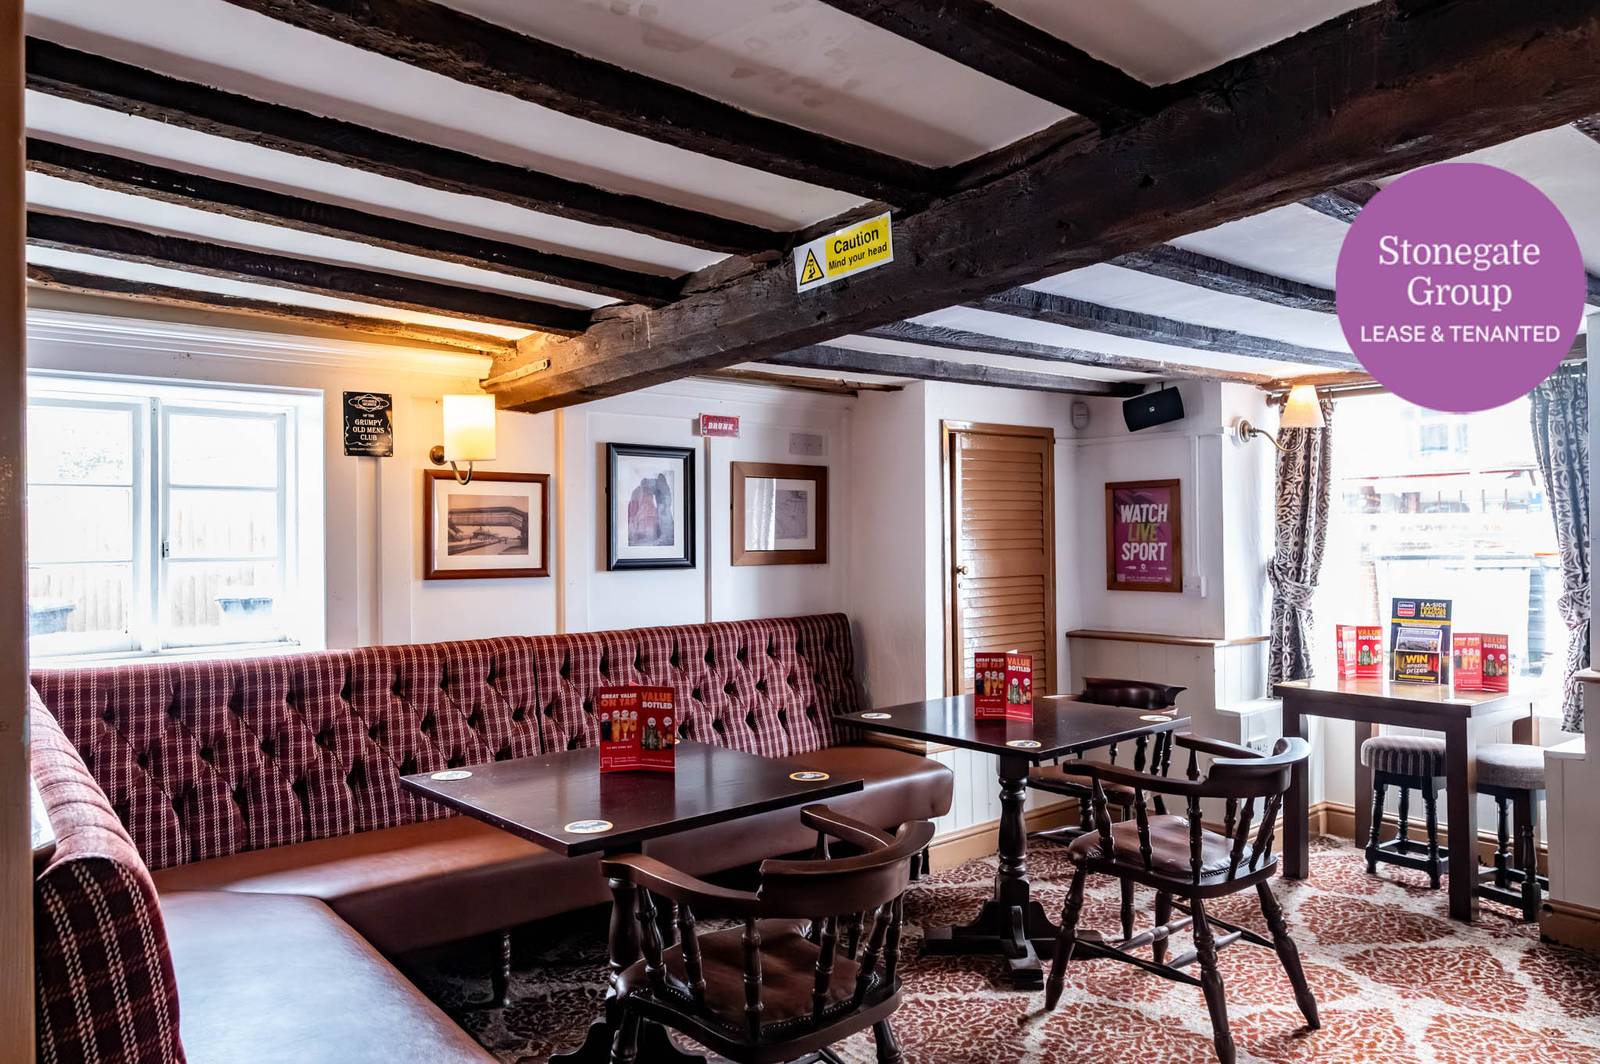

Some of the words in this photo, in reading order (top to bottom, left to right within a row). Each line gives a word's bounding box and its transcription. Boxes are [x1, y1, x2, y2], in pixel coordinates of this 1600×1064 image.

[834, 229, 879, 254] Caution
[828, 258, 847, 271] Mind
[848, 251, 866, 266] your
[867, 242, 888, 257] head
[366, 426, 385, 434] MENS
[1120, 503, 1168, 523] WATCH
[1127, 523, 1158, 541] LIVE
[1121, 542, 1168, 561] SPORT
[1007, 657, 1031, 667] VALUE
[1405, 655, 1428, 663] WIN
[641, 692, 672, 702] VALUE
[601, 699, 616, 707] ON
[642, 701, 673, 709] BOTTLED
